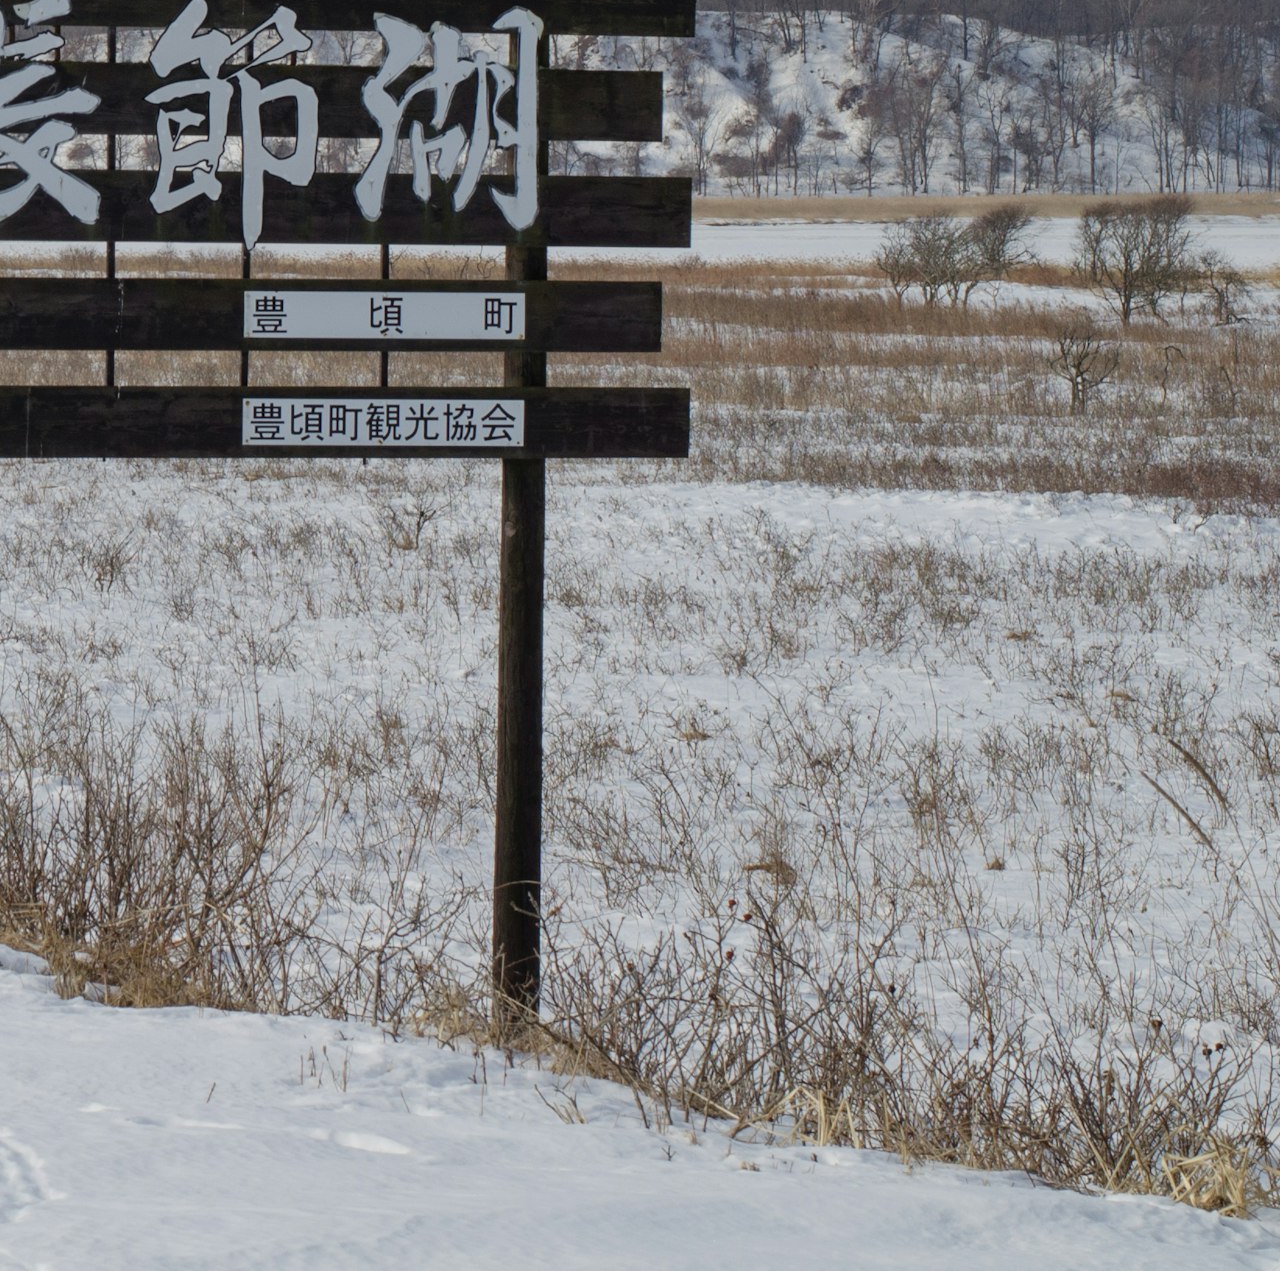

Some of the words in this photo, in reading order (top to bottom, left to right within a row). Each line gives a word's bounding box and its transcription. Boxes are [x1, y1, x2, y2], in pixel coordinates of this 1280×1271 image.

[250, 402, 516, 441] 豊頃町観光協会
